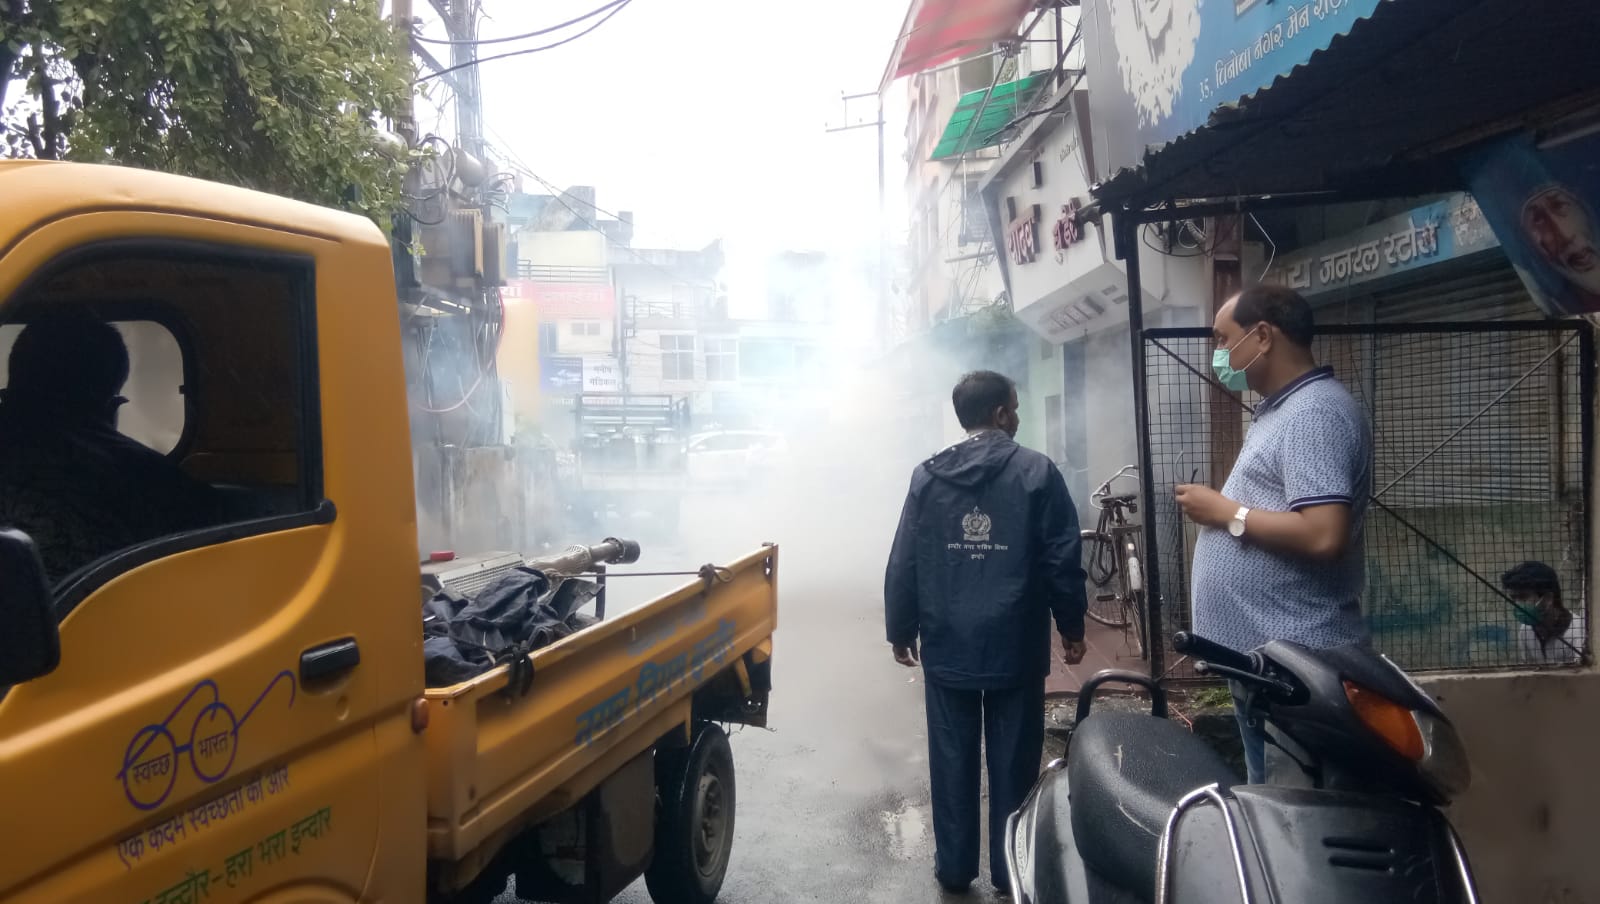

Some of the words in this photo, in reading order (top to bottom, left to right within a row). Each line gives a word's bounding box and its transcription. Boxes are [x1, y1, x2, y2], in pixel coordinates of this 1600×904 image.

[1215, 49, 1252, 88] विनोबा
[1254, 23, 1284, 59] नगर
[1287, 5, 1310, 39] मेन
[1319, 239, 1380, 284] जनरल
[198, 730, 229, 759] भारत
[132, 752, 171, 784] स्वच्छ
[117, 833, 145, 871] एक
[149, 812, 186, 852] कदम
[189, 786, 244, 833] स्वच्छता
[259, 827, 288, 865] भरा
